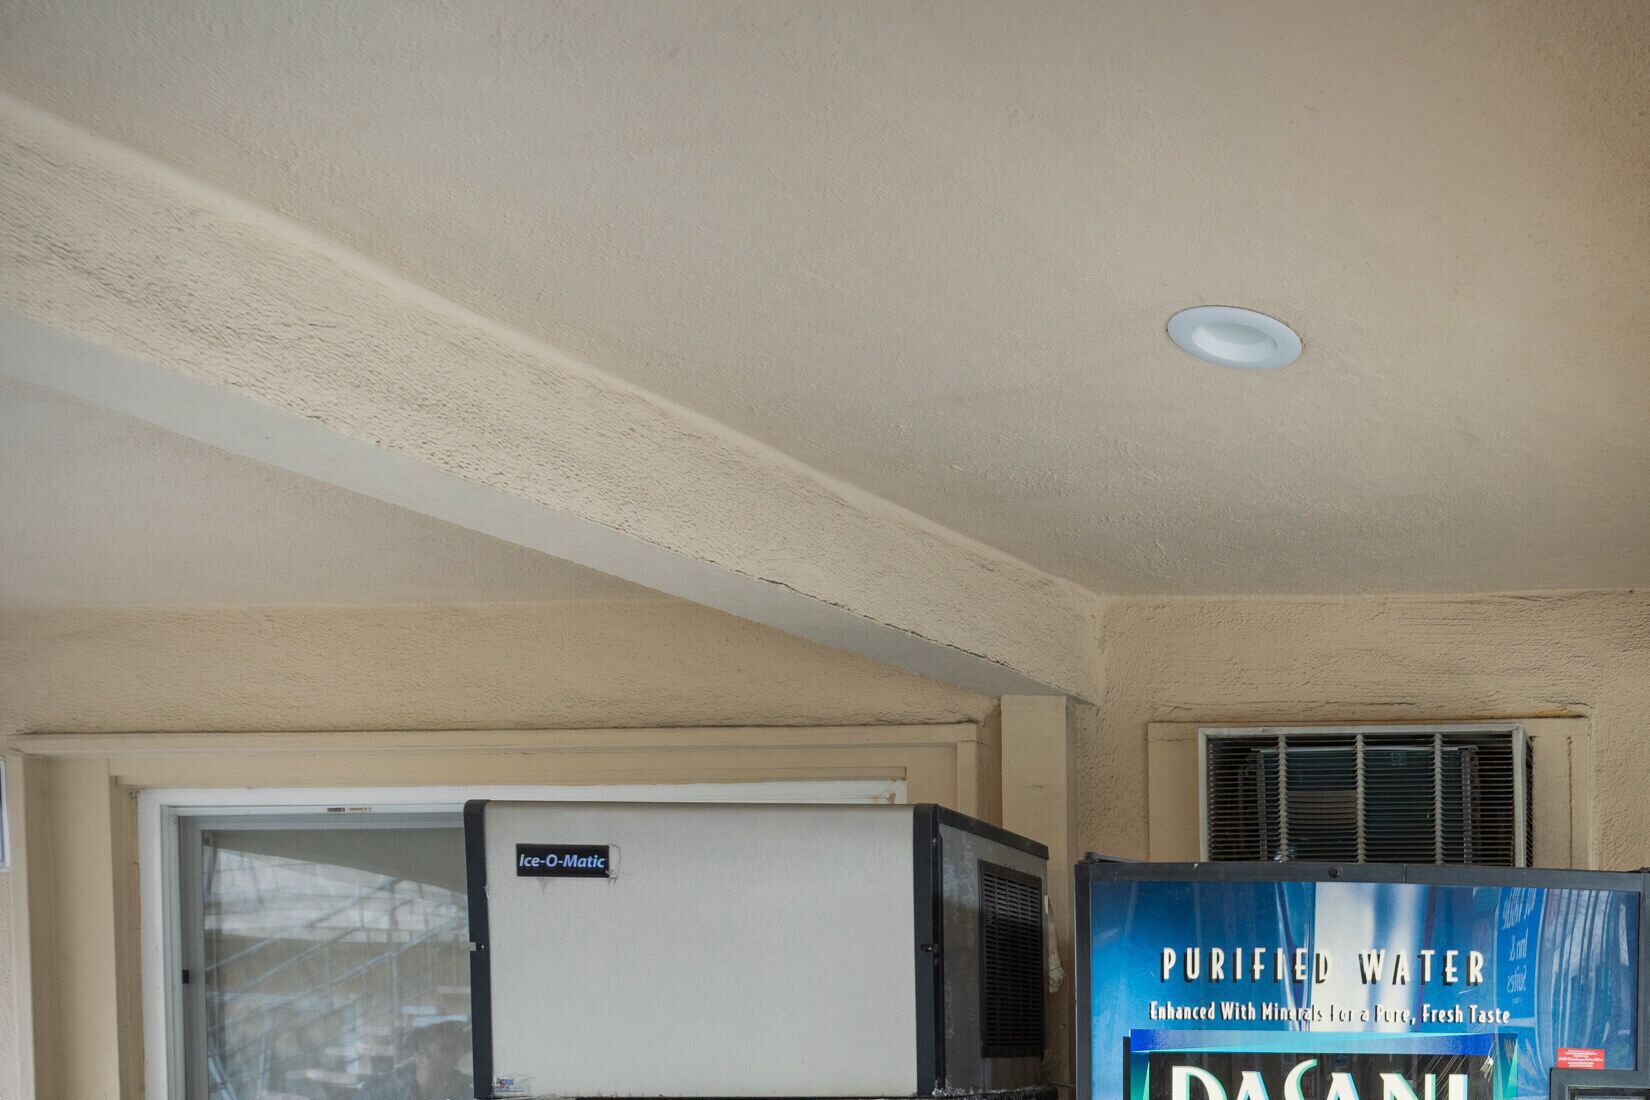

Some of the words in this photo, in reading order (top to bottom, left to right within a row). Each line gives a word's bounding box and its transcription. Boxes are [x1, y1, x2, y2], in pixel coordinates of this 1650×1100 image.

[519, 853, 605, 868] Ice-O-Matic
[1160, 946, 1332, 985] PURIFIED
[1359, 948, 1485, 986] WATER
[1149, 1000, 1215, 1022] Enhanced
[1220, 1001, 1256, 1022] With
[1261, 1001, 1322, 1023] Minerals
[1330, 1003, 1353, 1023] For
[1359, 1009, 1368, 1023] a
[1374, 1003, 1416, 1026] Pure,
[1420, 1003, 1464, 1025] Fresh
[1469, 1003, 1511, 1025] Taste
